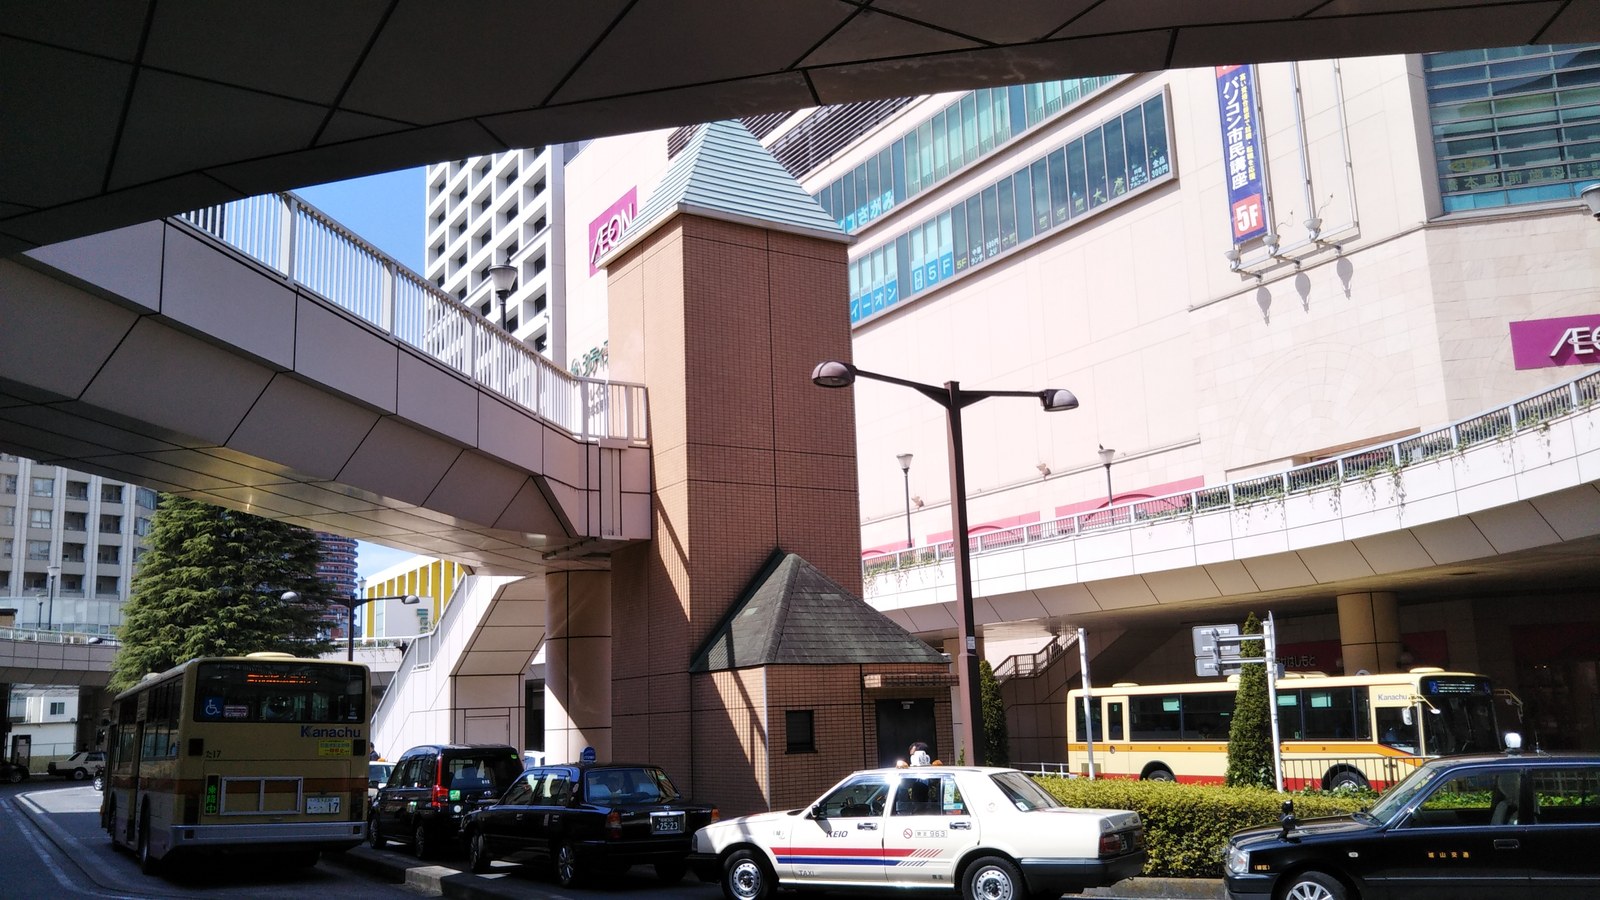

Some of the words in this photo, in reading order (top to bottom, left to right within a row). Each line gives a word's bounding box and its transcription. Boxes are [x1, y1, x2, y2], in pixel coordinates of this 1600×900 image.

[1223, 76, 1248, 190] パソコン市民講座
[1236, 204, 1258, 232] 5F
[591, 203, 633, 264] AEON
[956, 257, 967, 269] 5F
[300, 725, 361, 738] Kanachu
[826, 830, 848, 838] KEIO
[930, 830, 946, 838] 963
